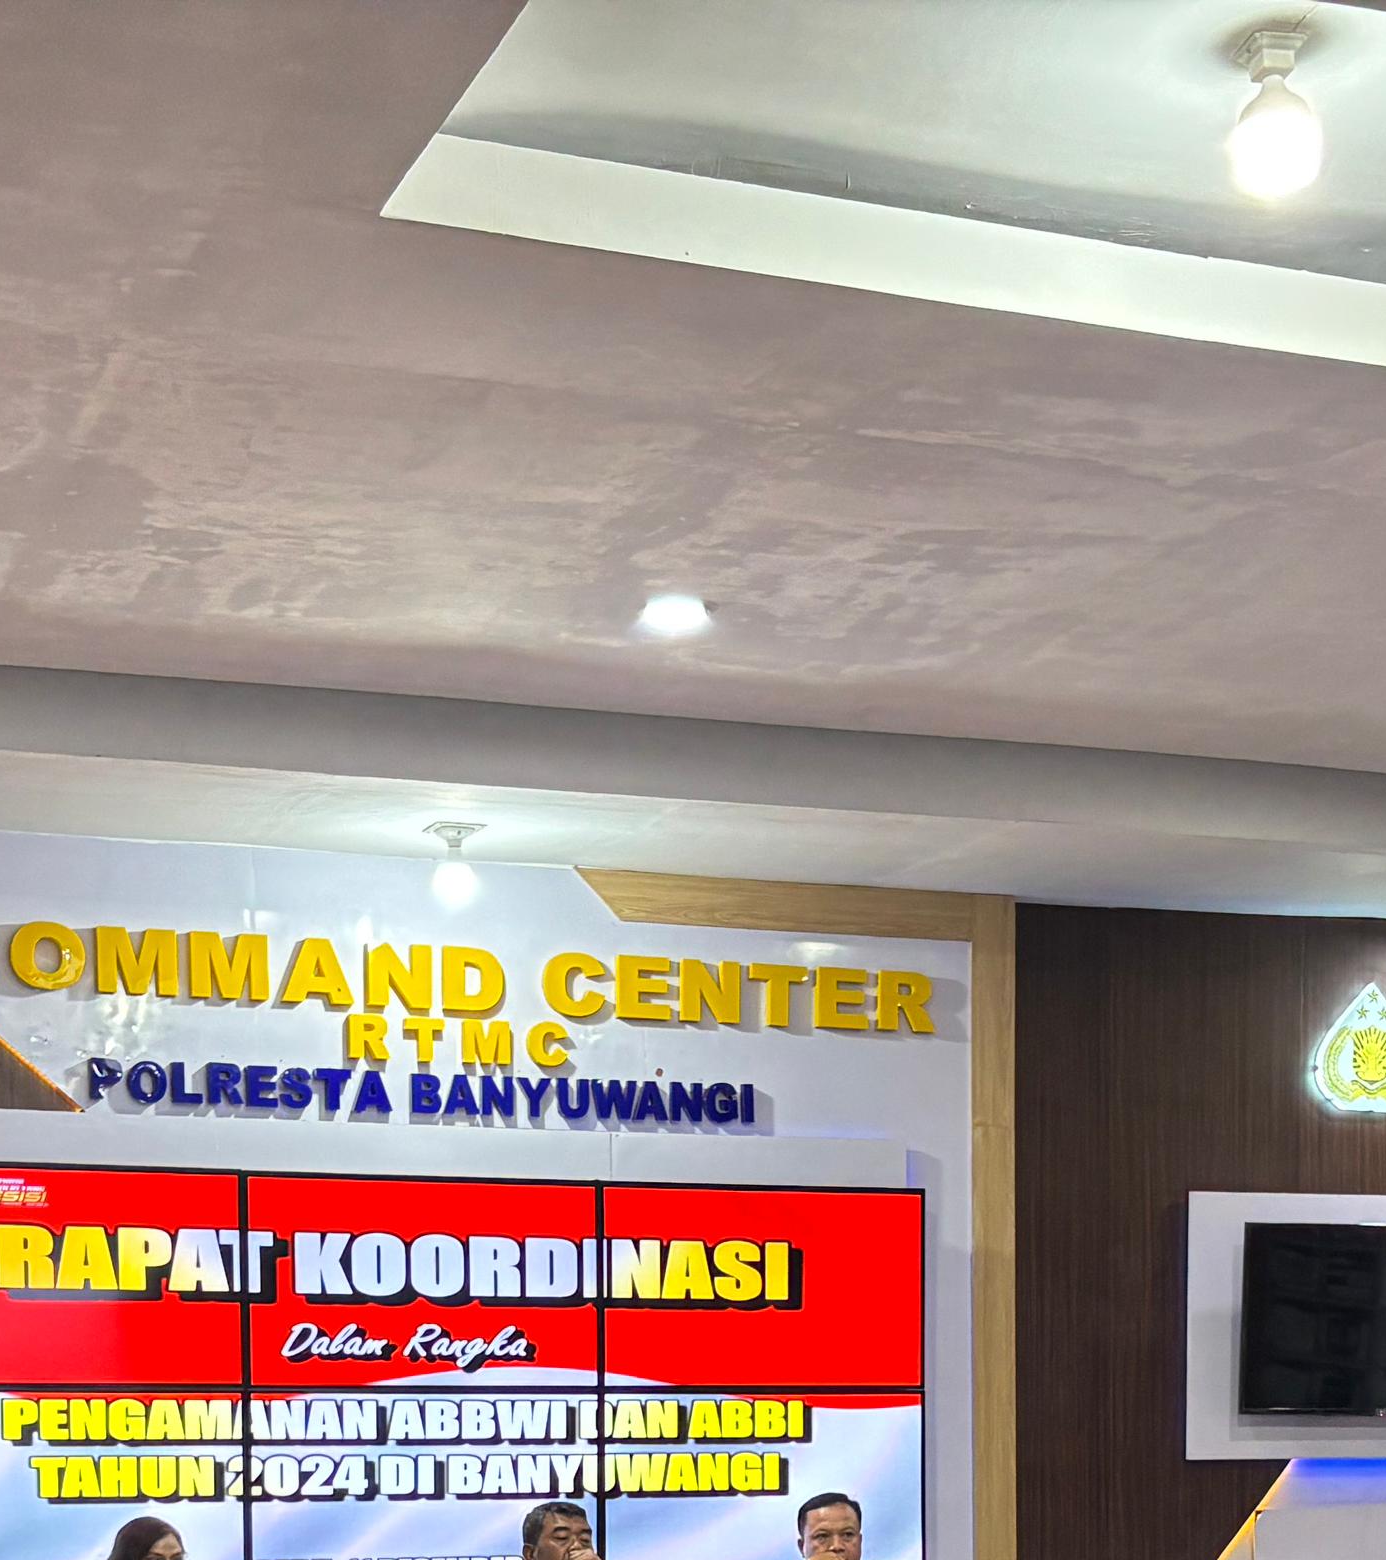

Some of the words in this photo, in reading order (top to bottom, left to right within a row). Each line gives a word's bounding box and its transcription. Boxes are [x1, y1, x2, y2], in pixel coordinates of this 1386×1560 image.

[542, 951, 935, 1034] CENTER
[89, 1057, 392, 1114] POLRESTA
[409, 1072, 756, 1125] BANYUWANGI
[294, 1230, 790, 1302] KOORDINASI
[281, 1323, 388, 1358] Dalam
[403, 1323, 529, 1368] Rangka
[2, 1398, 377, 1441] PENGAMANAN
[387, 1399, 568, 1440] ABBWI
[578, 1399, 680, 1440] DAN
[688, 1399, 805, 1439] ABBI
[29, 1456, 215, 1498] TAHUN
[225, 1455, 368, 1497] 2024
[378, 1454, 436, 1496] DI
[448, 1453, 781, 1495] BANYUWANGI
